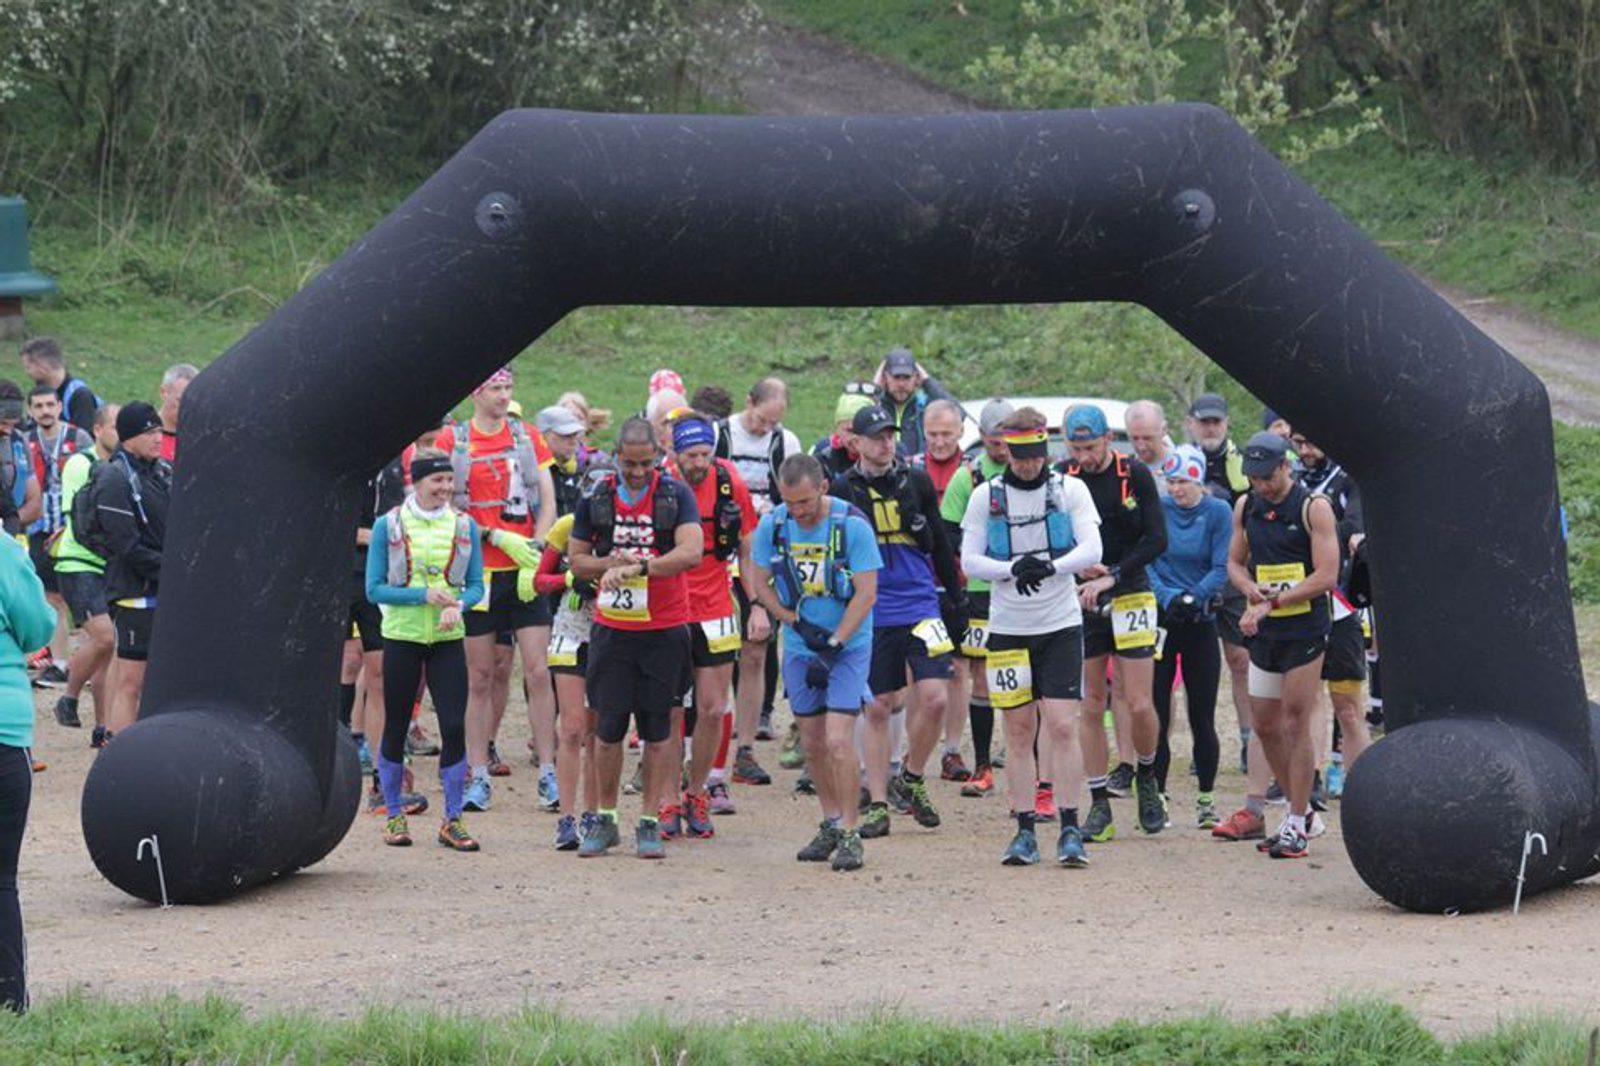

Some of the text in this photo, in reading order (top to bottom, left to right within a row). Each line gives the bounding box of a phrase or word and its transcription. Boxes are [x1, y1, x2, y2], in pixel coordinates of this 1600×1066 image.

[796, 561, 819, 583] 57
[611, 587, 634, 610] 23
[1126, 608, 1149, 632] 24
[995, 667, 1019, 692] 48
